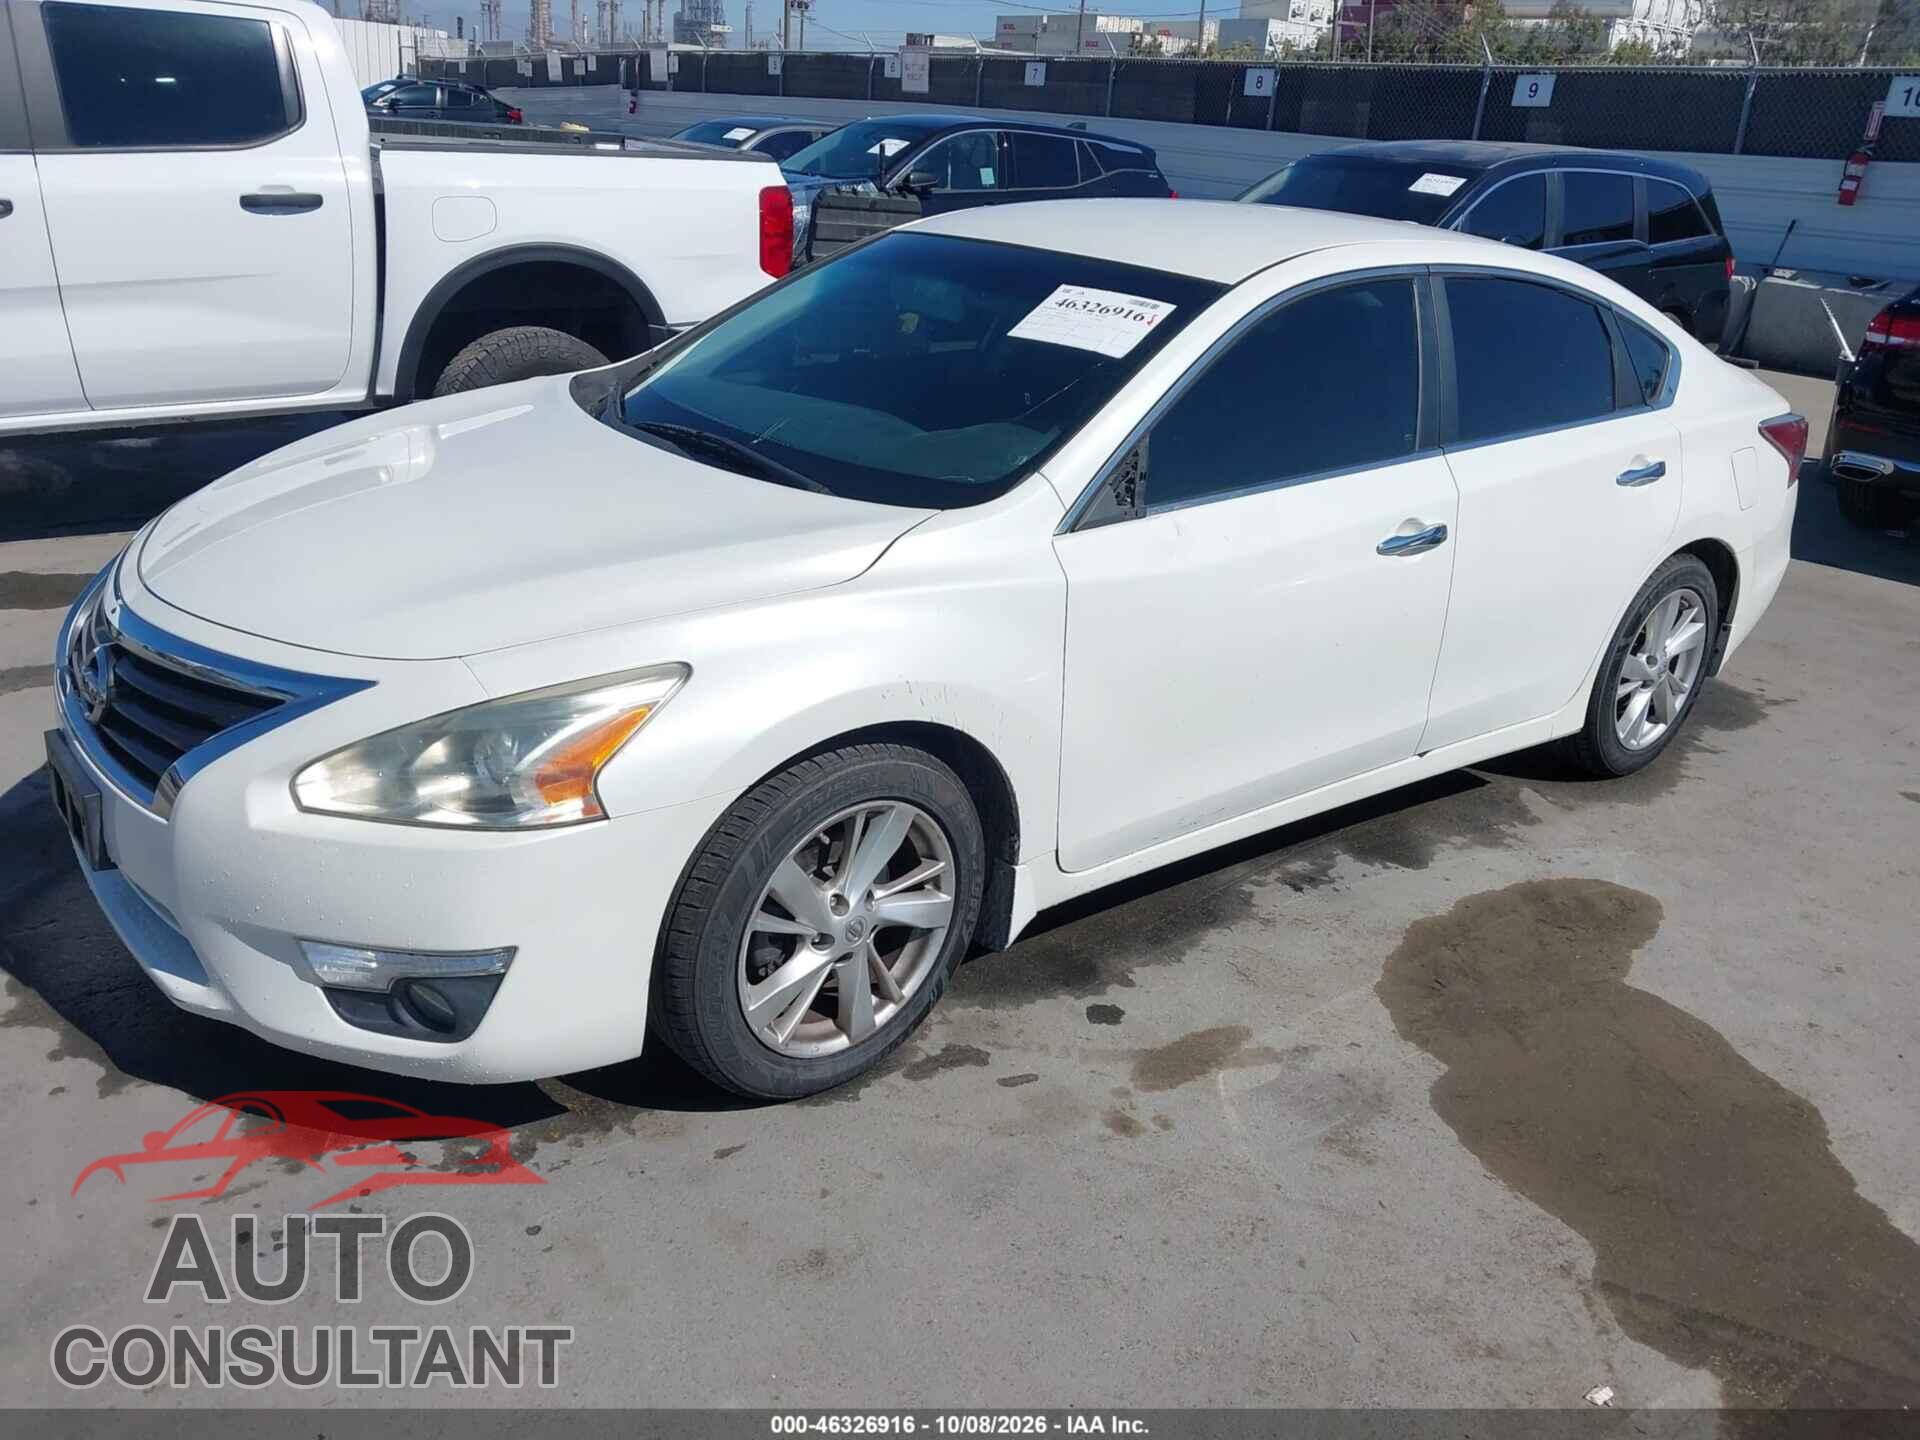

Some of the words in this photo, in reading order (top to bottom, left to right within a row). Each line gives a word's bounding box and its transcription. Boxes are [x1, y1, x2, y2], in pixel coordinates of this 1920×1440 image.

[1256, 75, 1263, 89] 8
[1528, 82, 1538, 98] 9
[1055, 298, 1145, 321] 46326916
